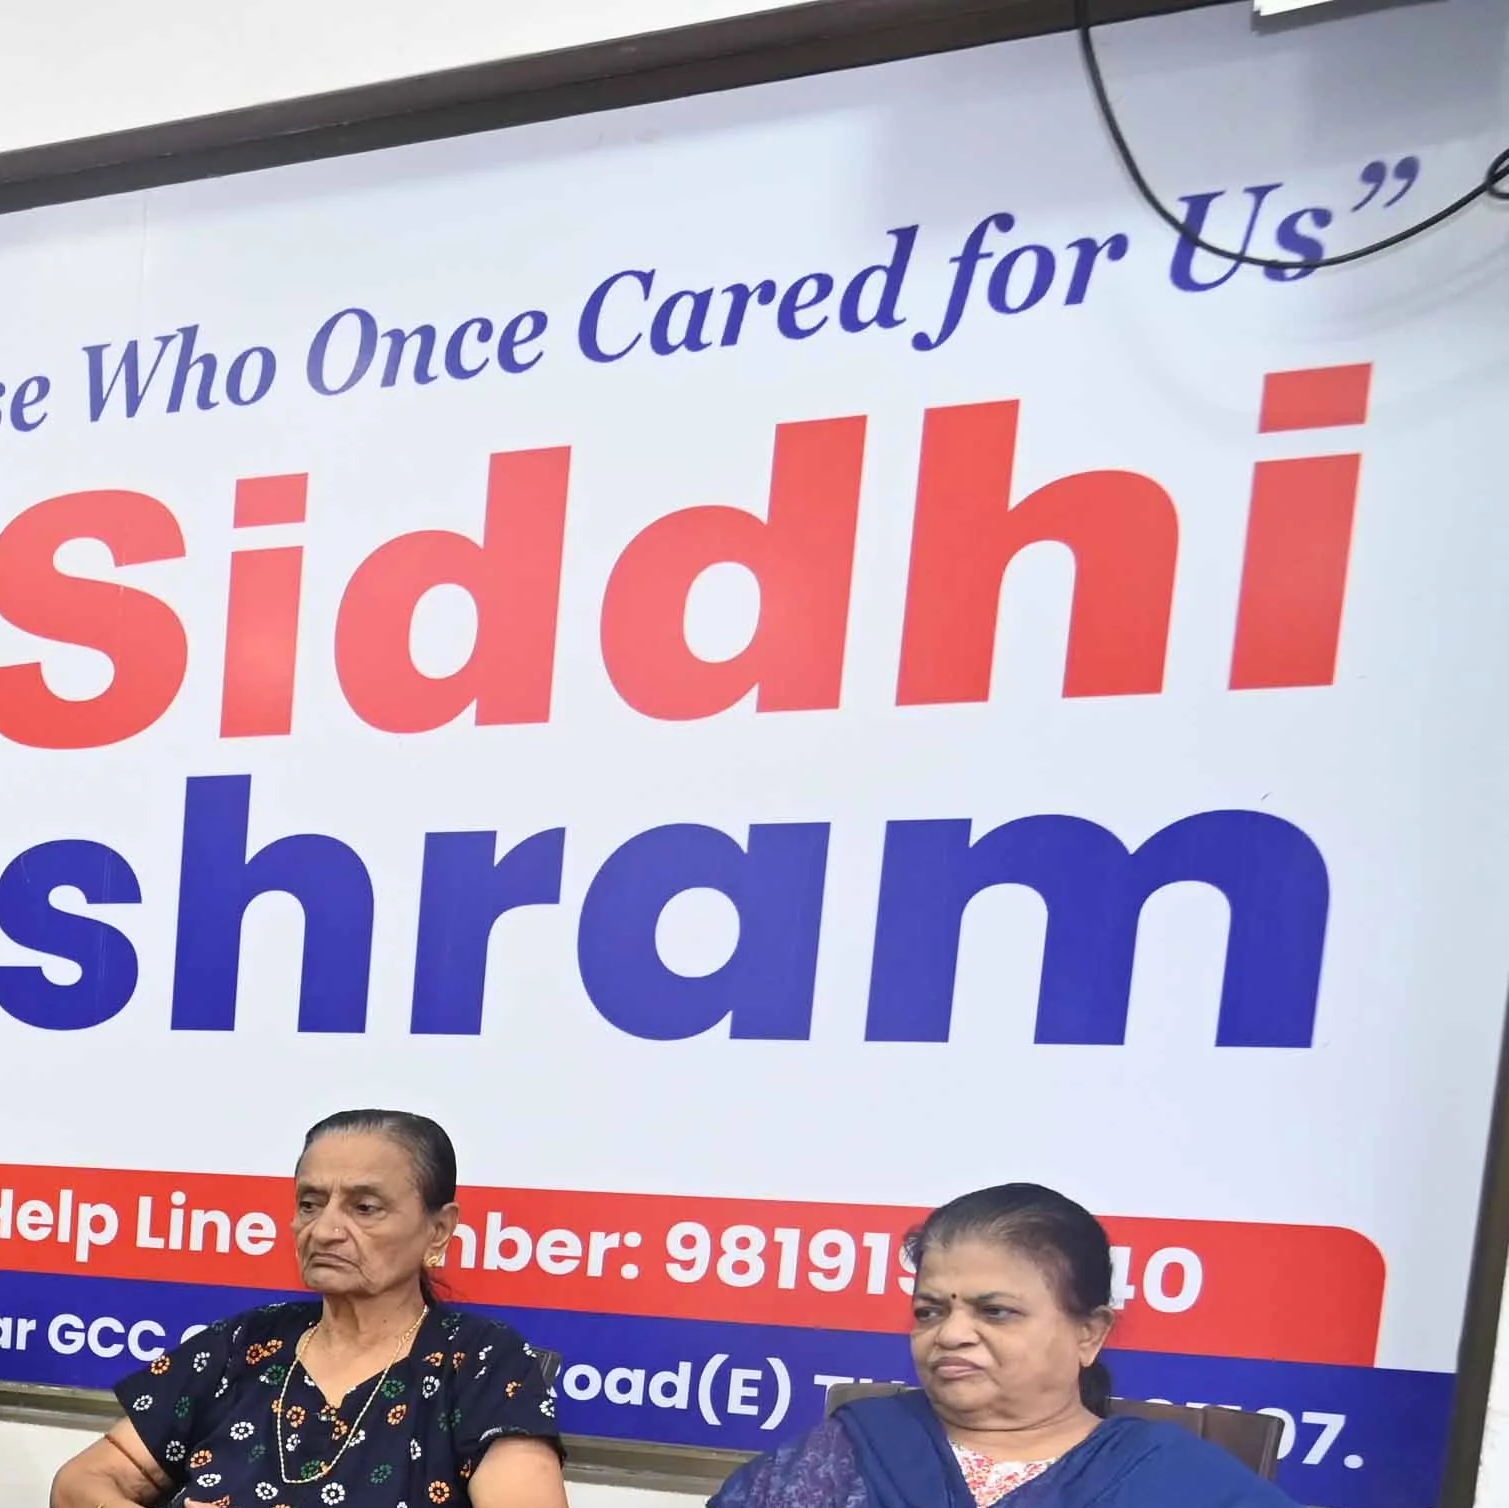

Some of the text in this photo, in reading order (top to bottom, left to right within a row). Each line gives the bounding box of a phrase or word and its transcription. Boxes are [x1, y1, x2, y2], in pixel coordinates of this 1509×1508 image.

[84, 326, 275, 421] Who
[309, 309, 548, 394] Once
[578, 225, 918, 362] Cared
[912, 213, 1129, 351] for
[1170, 156, 1419, 292] Us”
[136, 1191, 277, 1256] Line
[47, 1313, 167, 1363] GCC
[555, 1354, 792, 1430] oad(E)
